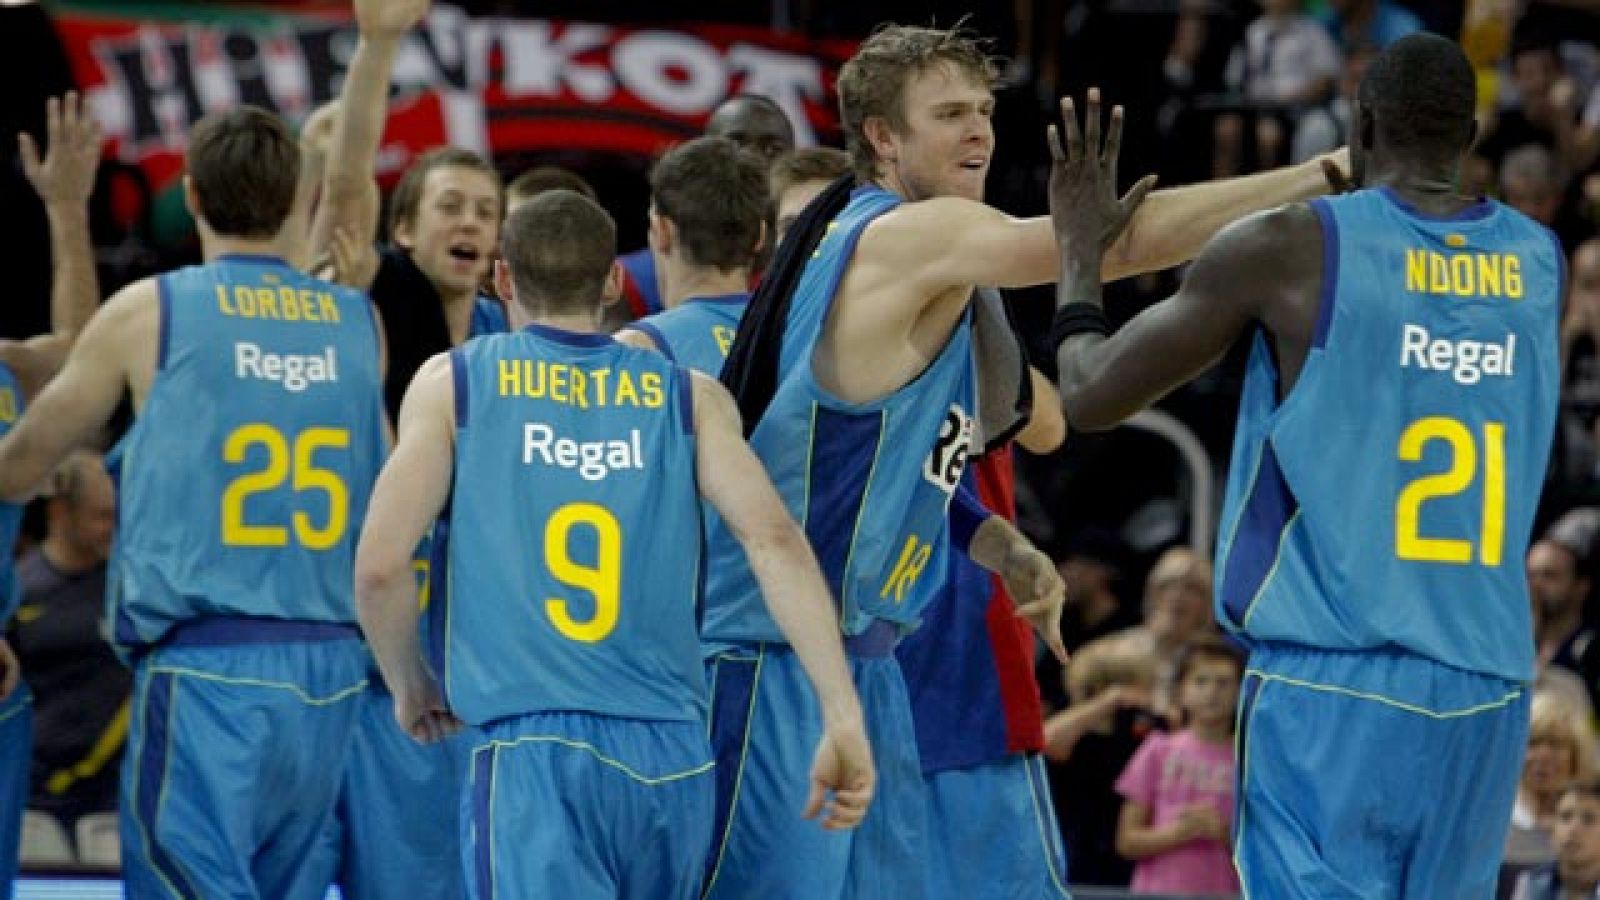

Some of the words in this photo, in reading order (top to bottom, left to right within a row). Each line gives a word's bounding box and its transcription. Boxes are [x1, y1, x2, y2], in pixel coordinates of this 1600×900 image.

[1405, 248, 1524, 299] NDONG
[234, 342, 338, 392] Regal
[1399, 323, 1517, 384] Regal
[498, 358, 665, 410] HUERTAS
[522, 422, 644, 481] Regal
[220, 422, 351, 551] 25
[1394, 415, 1507, 568] 21
[543, 502, 623, 644] 9
